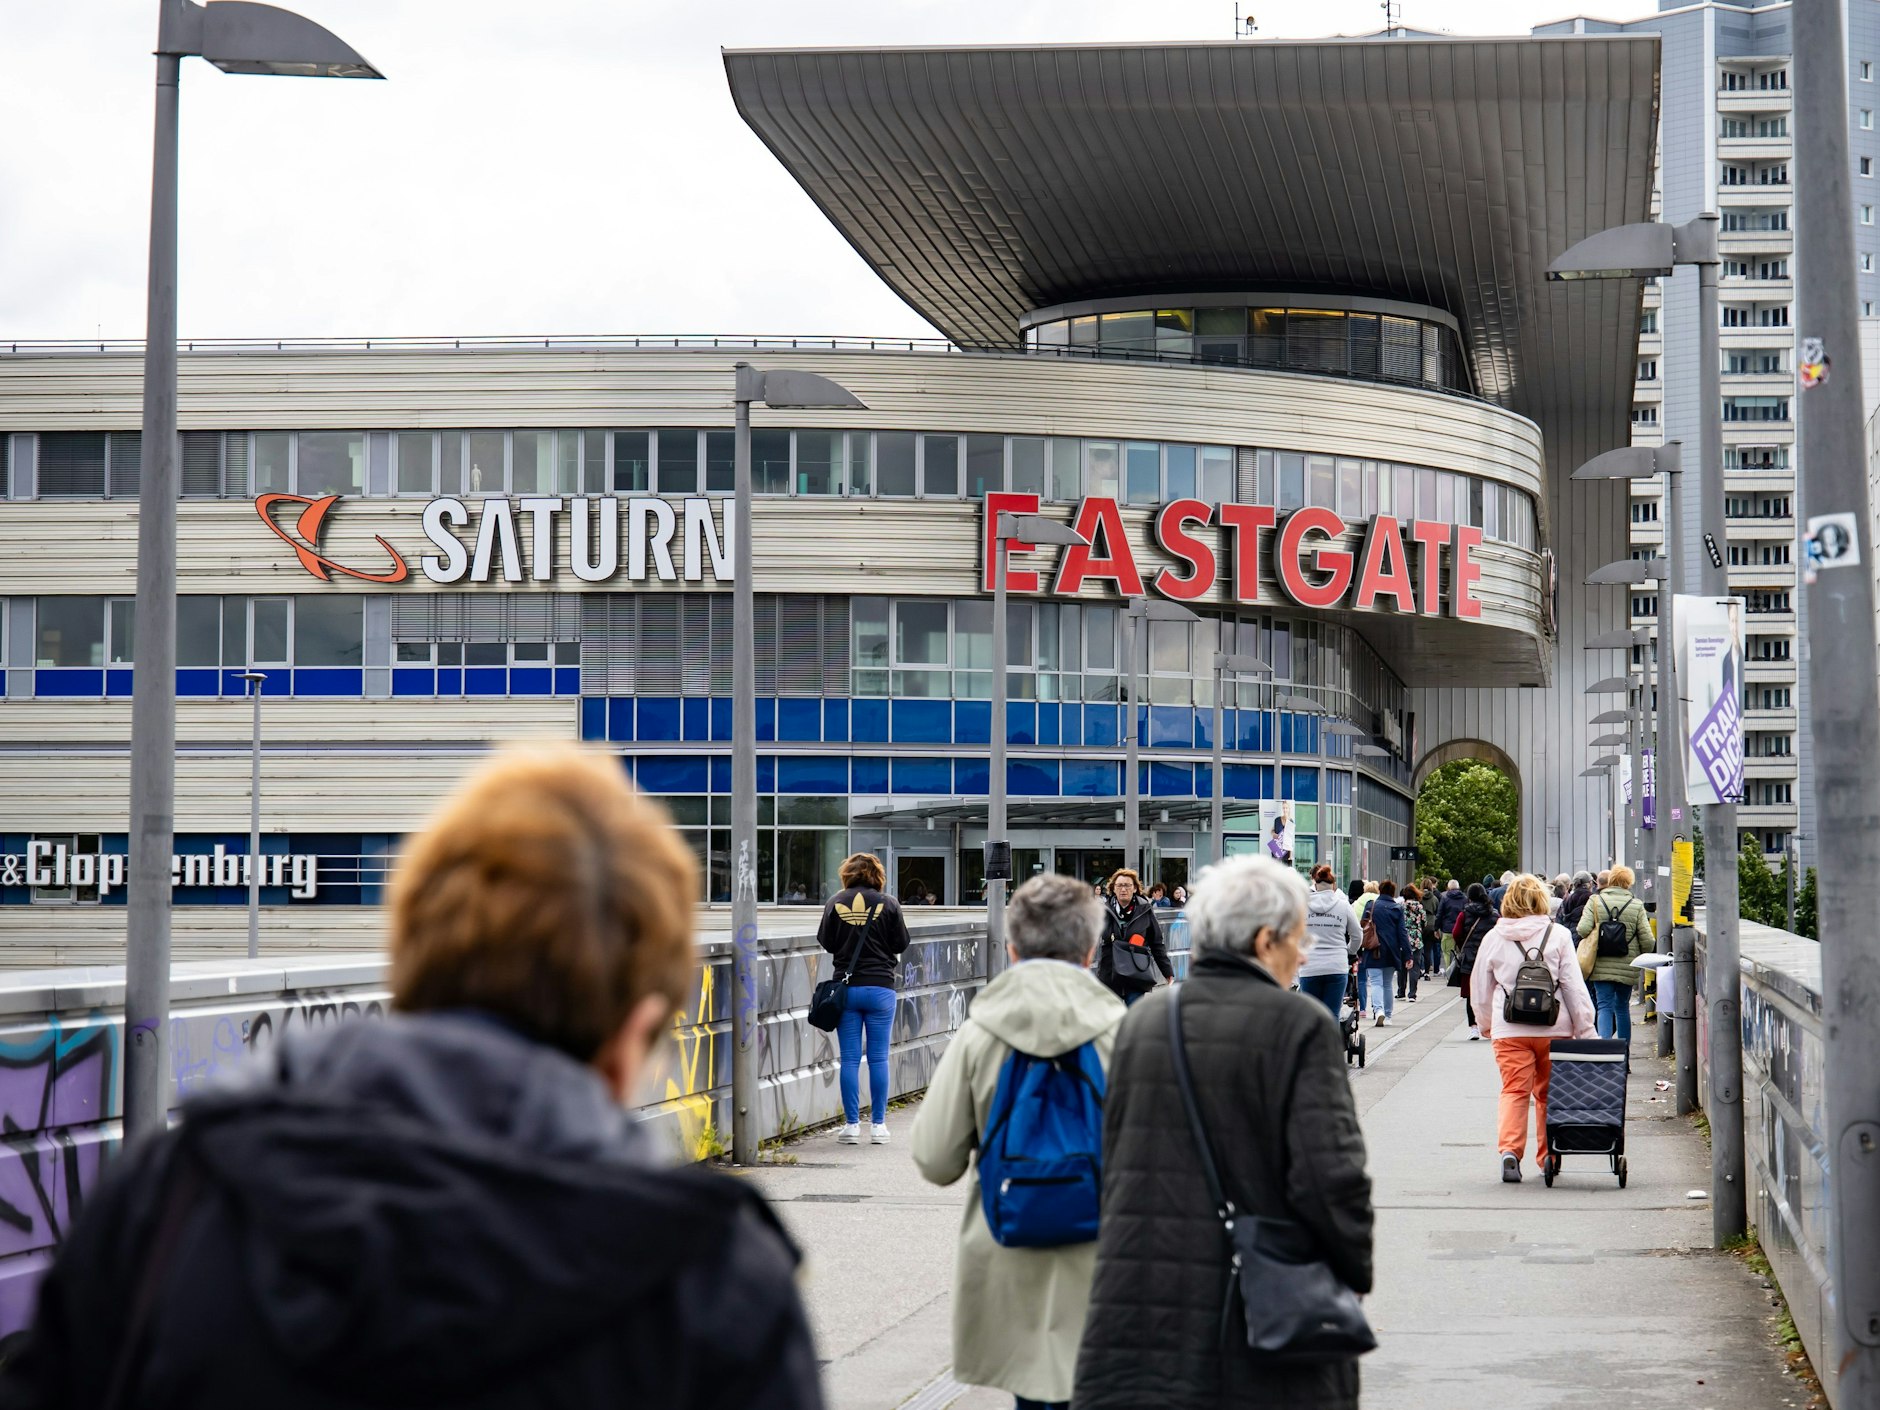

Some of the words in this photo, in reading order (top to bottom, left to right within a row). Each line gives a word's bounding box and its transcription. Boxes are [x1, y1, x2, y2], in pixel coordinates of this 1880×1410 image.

[421, 497, 734, 583] SATURN
[982, 491, 1483, 619] EASTGATE
[1696, 691, 1737, 761] TRAU
